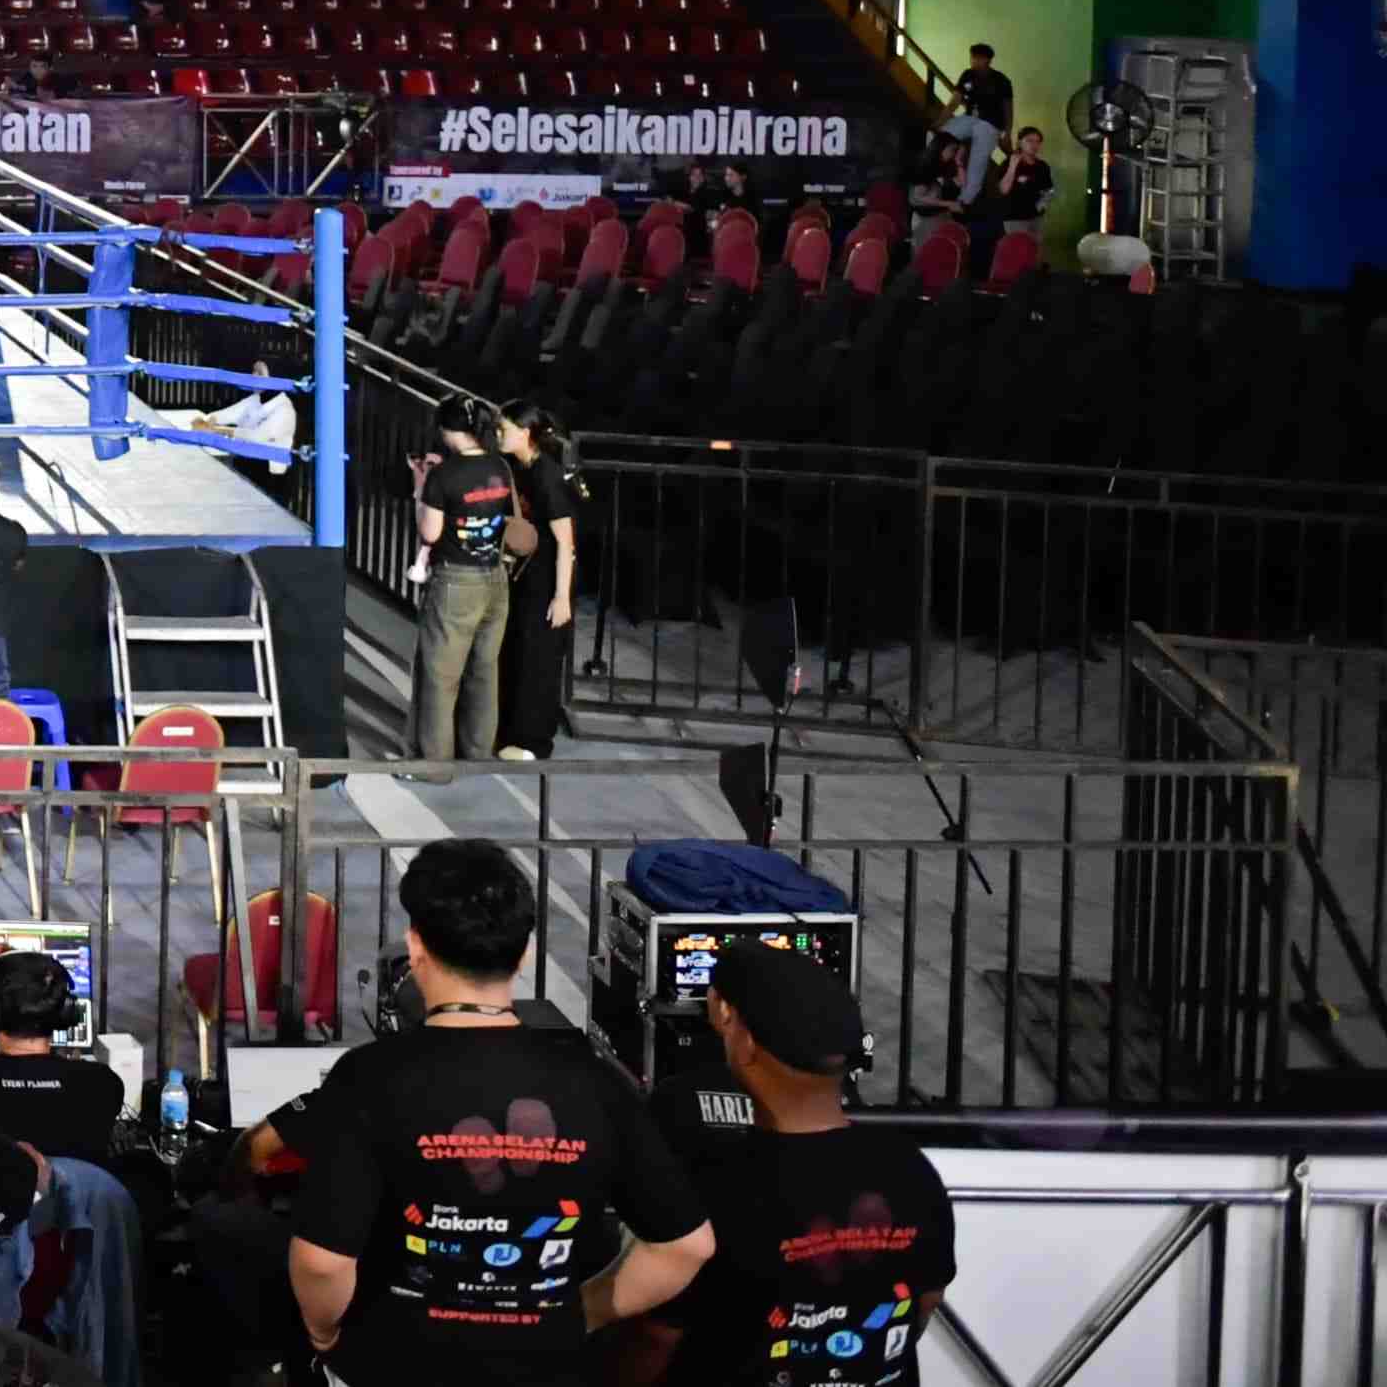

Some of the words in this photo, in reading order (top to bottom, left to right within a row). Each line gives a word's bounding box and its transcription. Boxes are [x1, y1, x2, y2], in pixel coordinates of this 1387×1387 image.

[439, 105, 847, 155] #SelesaikanDiArena
[417, 1134, 491, 1148] ARENA
[493, 1135, 587, 1152] SELATAN
[422, 1147, 579, 1163] CHAMPIONSHIP
[433, 1204, 459, 1214] Bank
[425, 1214, 509, 1232] Jakarta
[428, 1240, 462, 1254] PLN
